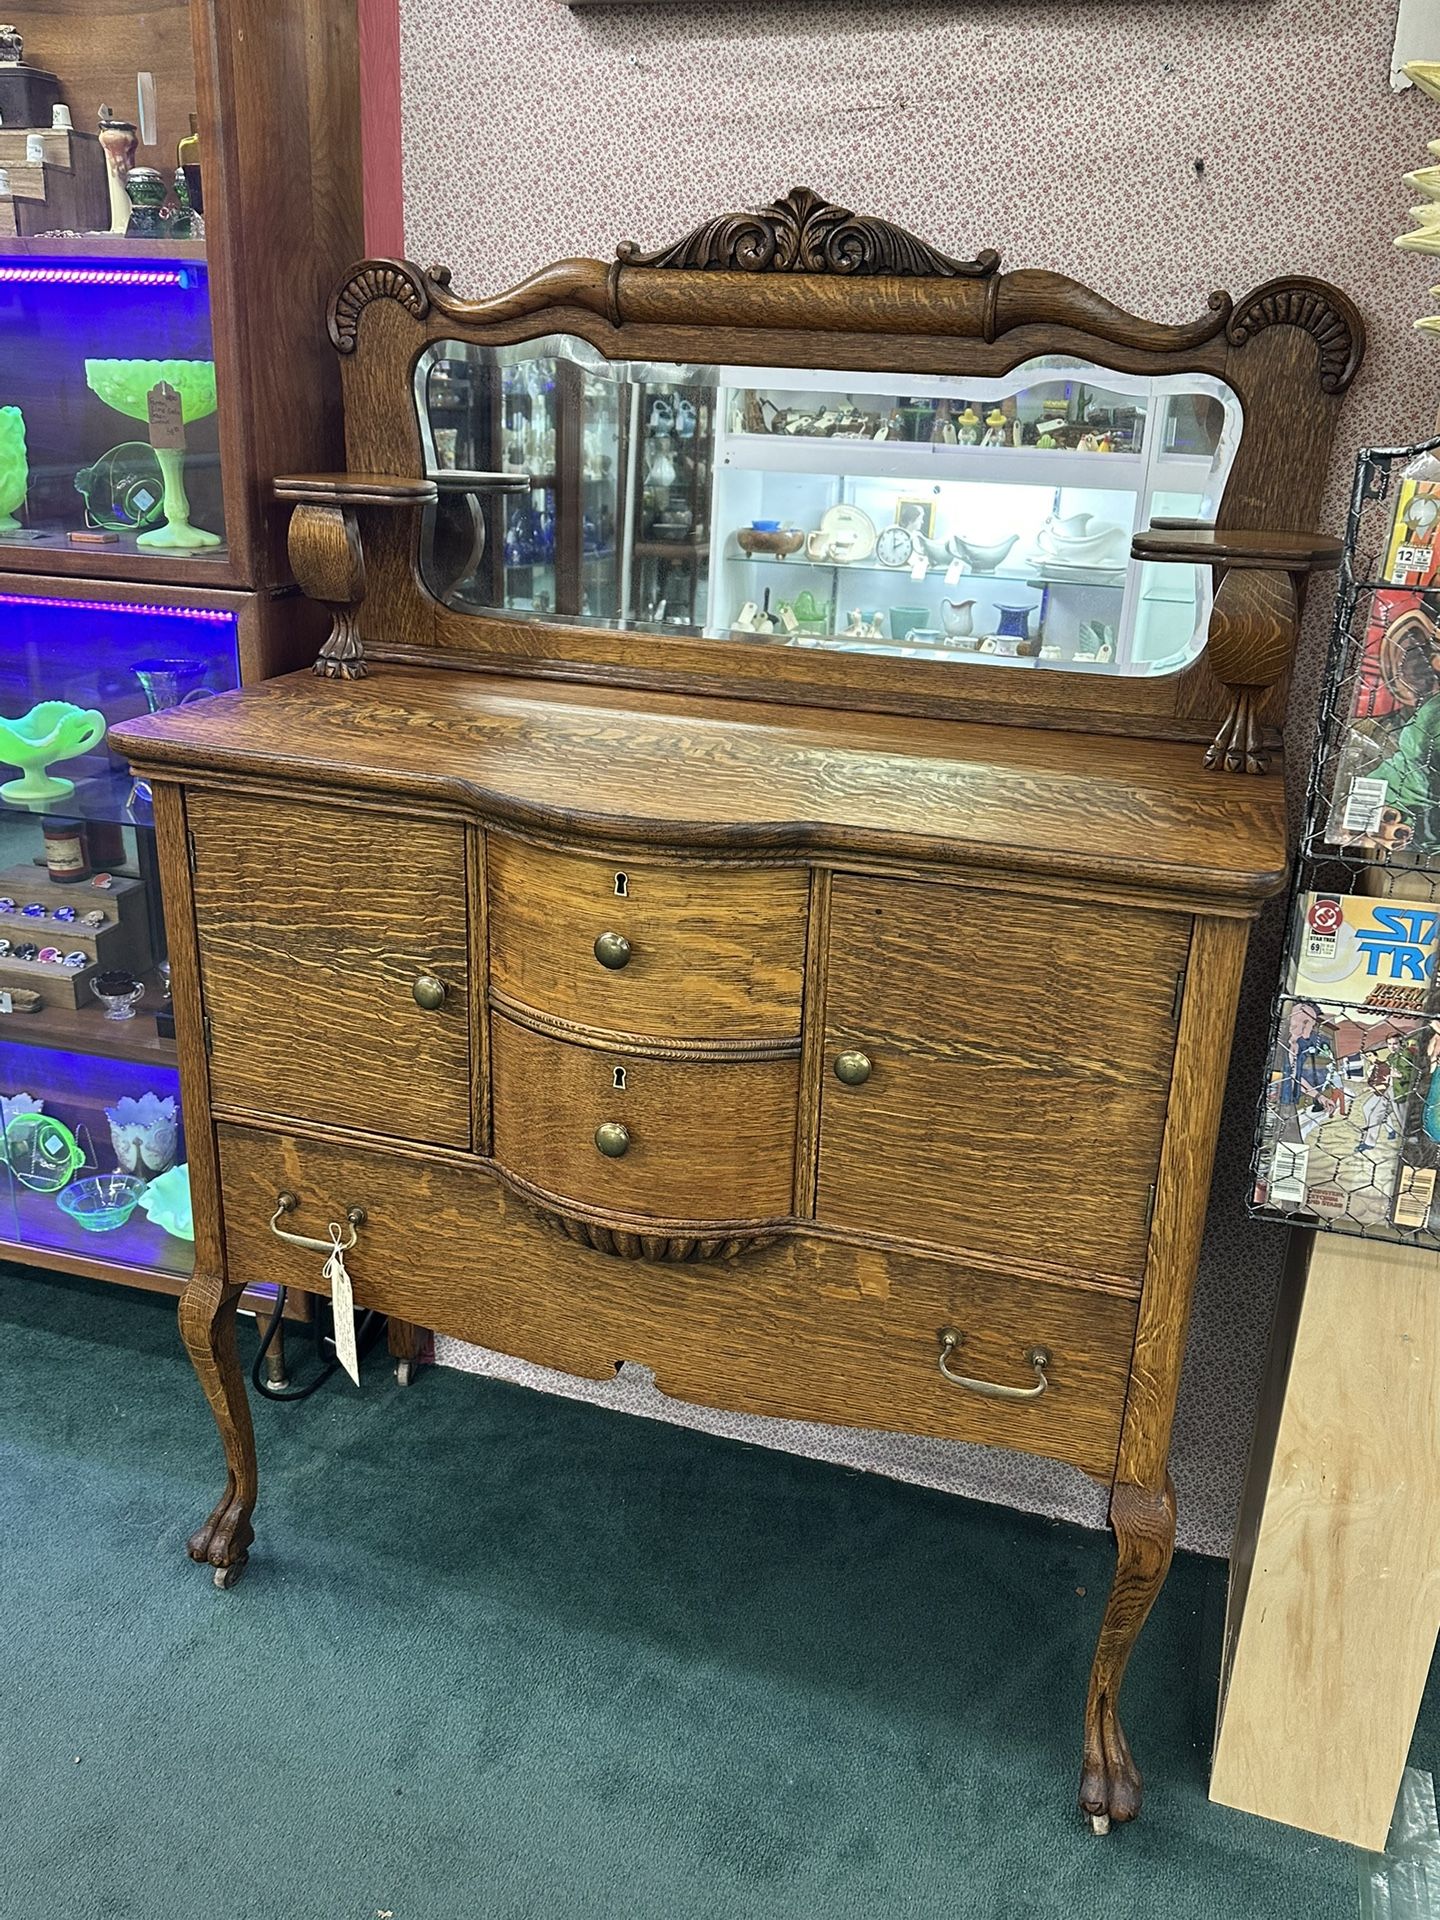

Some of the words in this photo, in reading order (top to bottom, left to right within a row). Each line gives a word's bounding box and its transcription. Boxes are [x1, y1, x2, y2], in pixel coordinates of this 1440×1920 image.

[1398, 550, 1413, 561] 12
[1317, 908, 1335, 924] DC
[1310, 943, 1320, 952] 69
